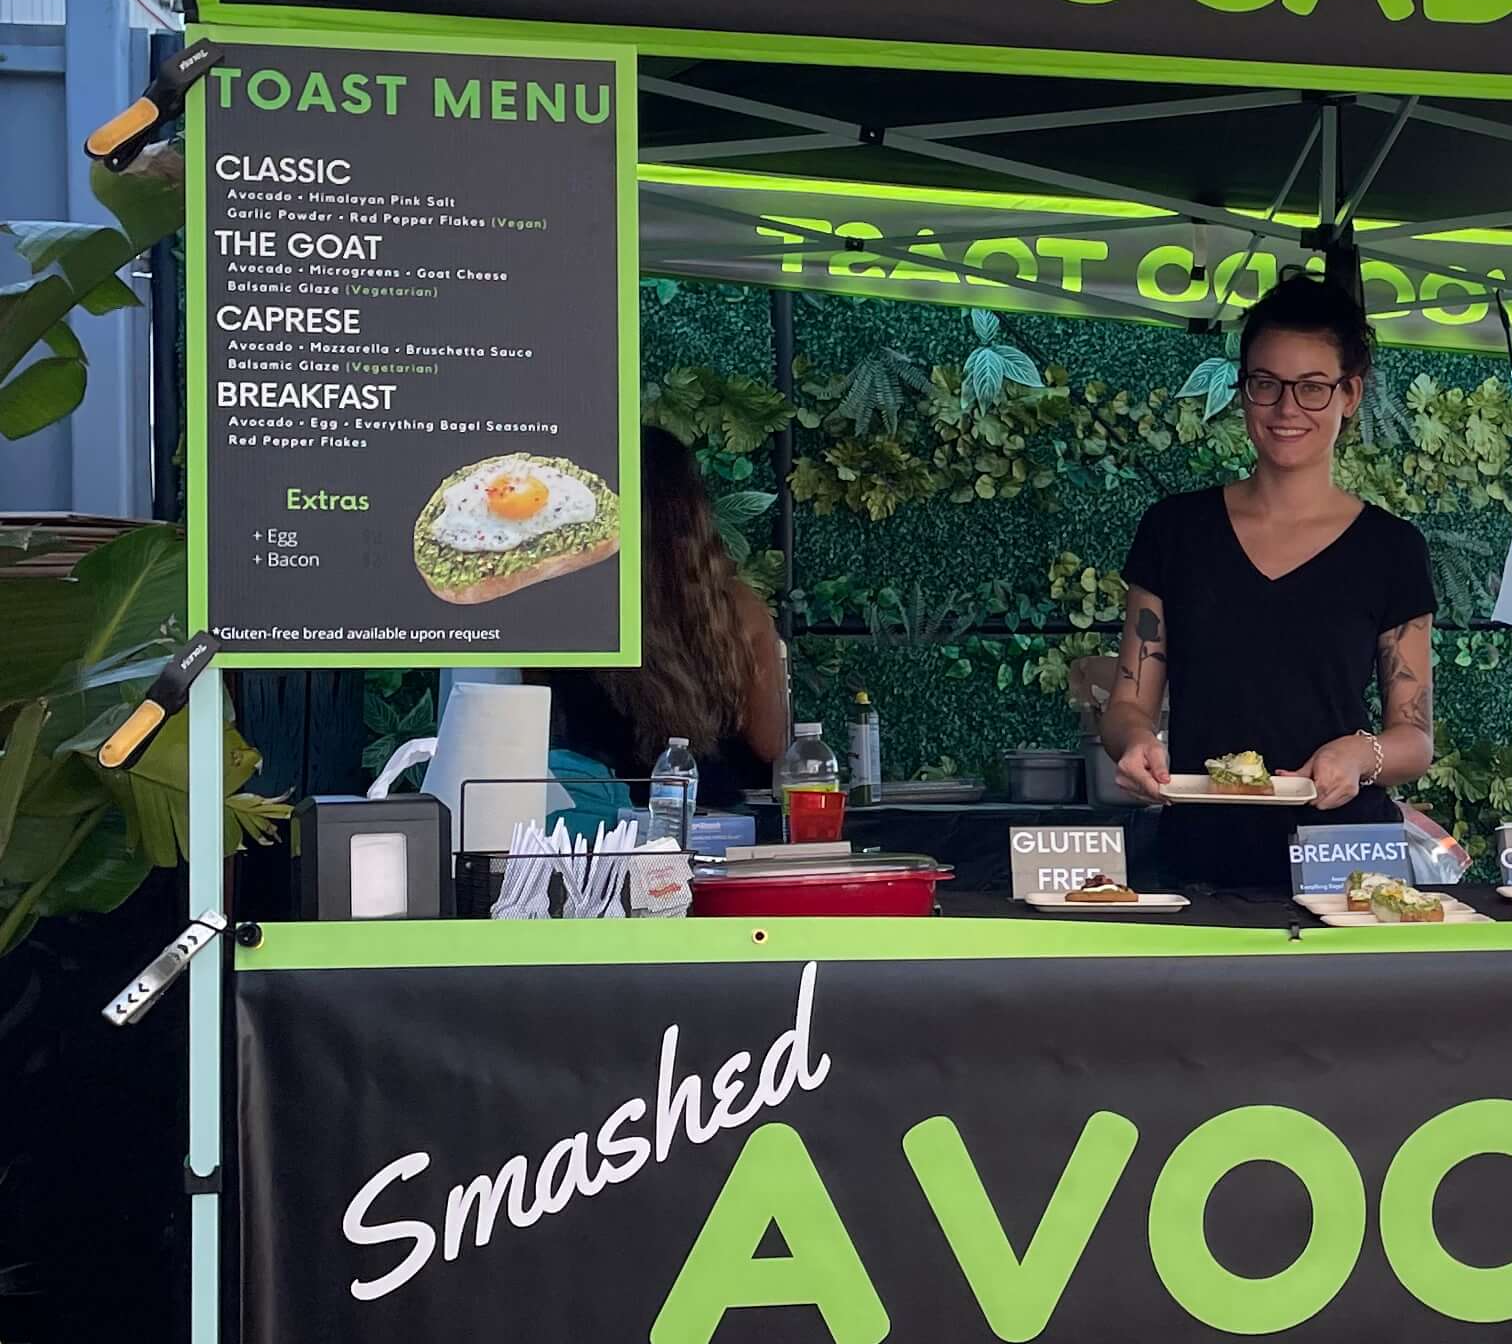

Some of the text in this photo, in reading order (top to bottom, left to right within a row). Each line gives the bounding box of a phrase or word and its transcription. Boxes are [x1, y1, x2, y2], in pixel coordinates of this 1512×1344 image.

[209, 67, 610, 124] TOAST MENU
[215, 155, 351, 185] CLASSIC
[227, 188, 455, 208] Avocado Himalayan Pink Salt
[227, 207, 547, 231] Garlic Powder Red Pepper Flakes (Vegan)
[214, 230, 383, 260] THE GOAT
[228, 262, 508, 281] Avocado Microgreens Goat Cheese
[227, 280, 438, 298] Balsamic Glaze (Vegetarian)
[216, 305, 361, 334] CAPRESE
[228, 339, 533, 358] Avocado Mozzarella Bruschetta Sauce
[228, 358, 438, 375] Balsamic Glaze (Vegetarian)
[217, 381, 397, 410] BREAKFAST
[228, 416, 558, 434] Avocado Egg Everything Bagel Seasoning
[228, 434, 367, 449] Red Pepper Flakes
[287, 488, 370, 511] Extras
[267, 528, 298, 548] Egg
[268, 551, 320, 567] Bacon
[303, 627, 344, 640] bread
[346, 627, 407, 640] available
[410, 629, 446, 643] upon
[449, 629, 501, 643] request
[1012, 831, 1122, 853] GLUTEN
[1289, 842, 1409, 863] BREAKFAST
[342, 960, 831, 1301] Smashed
